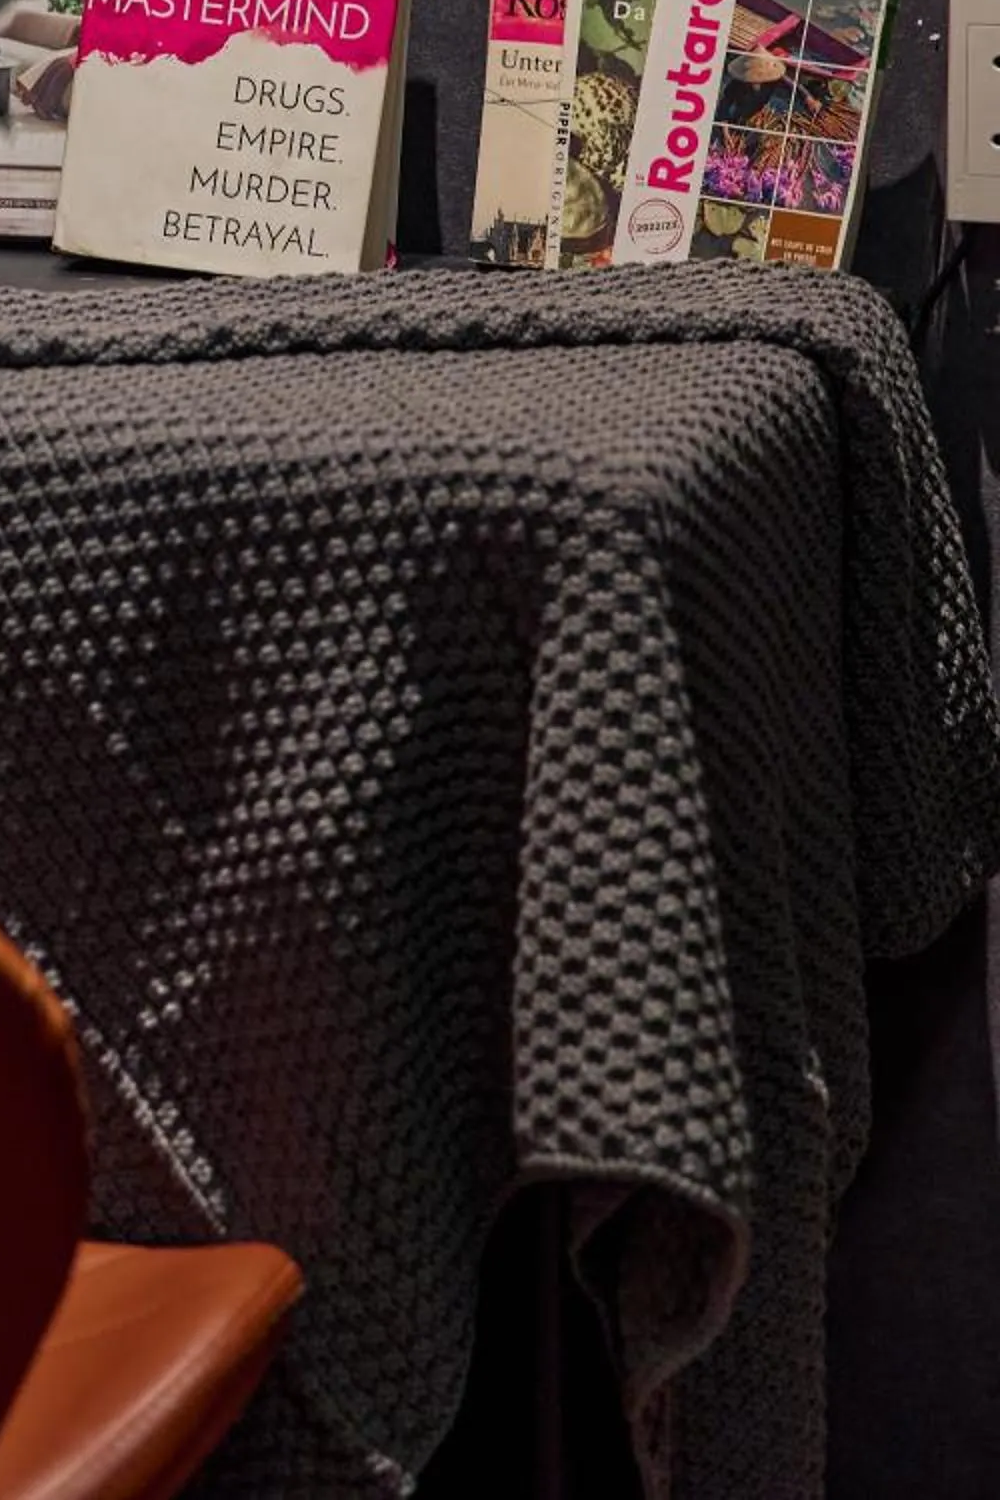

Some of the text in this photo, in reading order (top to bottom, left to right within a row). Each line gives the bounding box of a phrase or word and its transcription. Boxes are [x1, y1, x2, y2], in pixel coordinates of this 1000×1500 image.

[234, 75, 352, 117] DRUGS.
[216, 122, 344, 165] EMPIRE.
[554, 102, 571, 146] PIPER
[189, 166, 338, 211] MURDER.
[162, 211, 330, 259] BETRAYAL.
